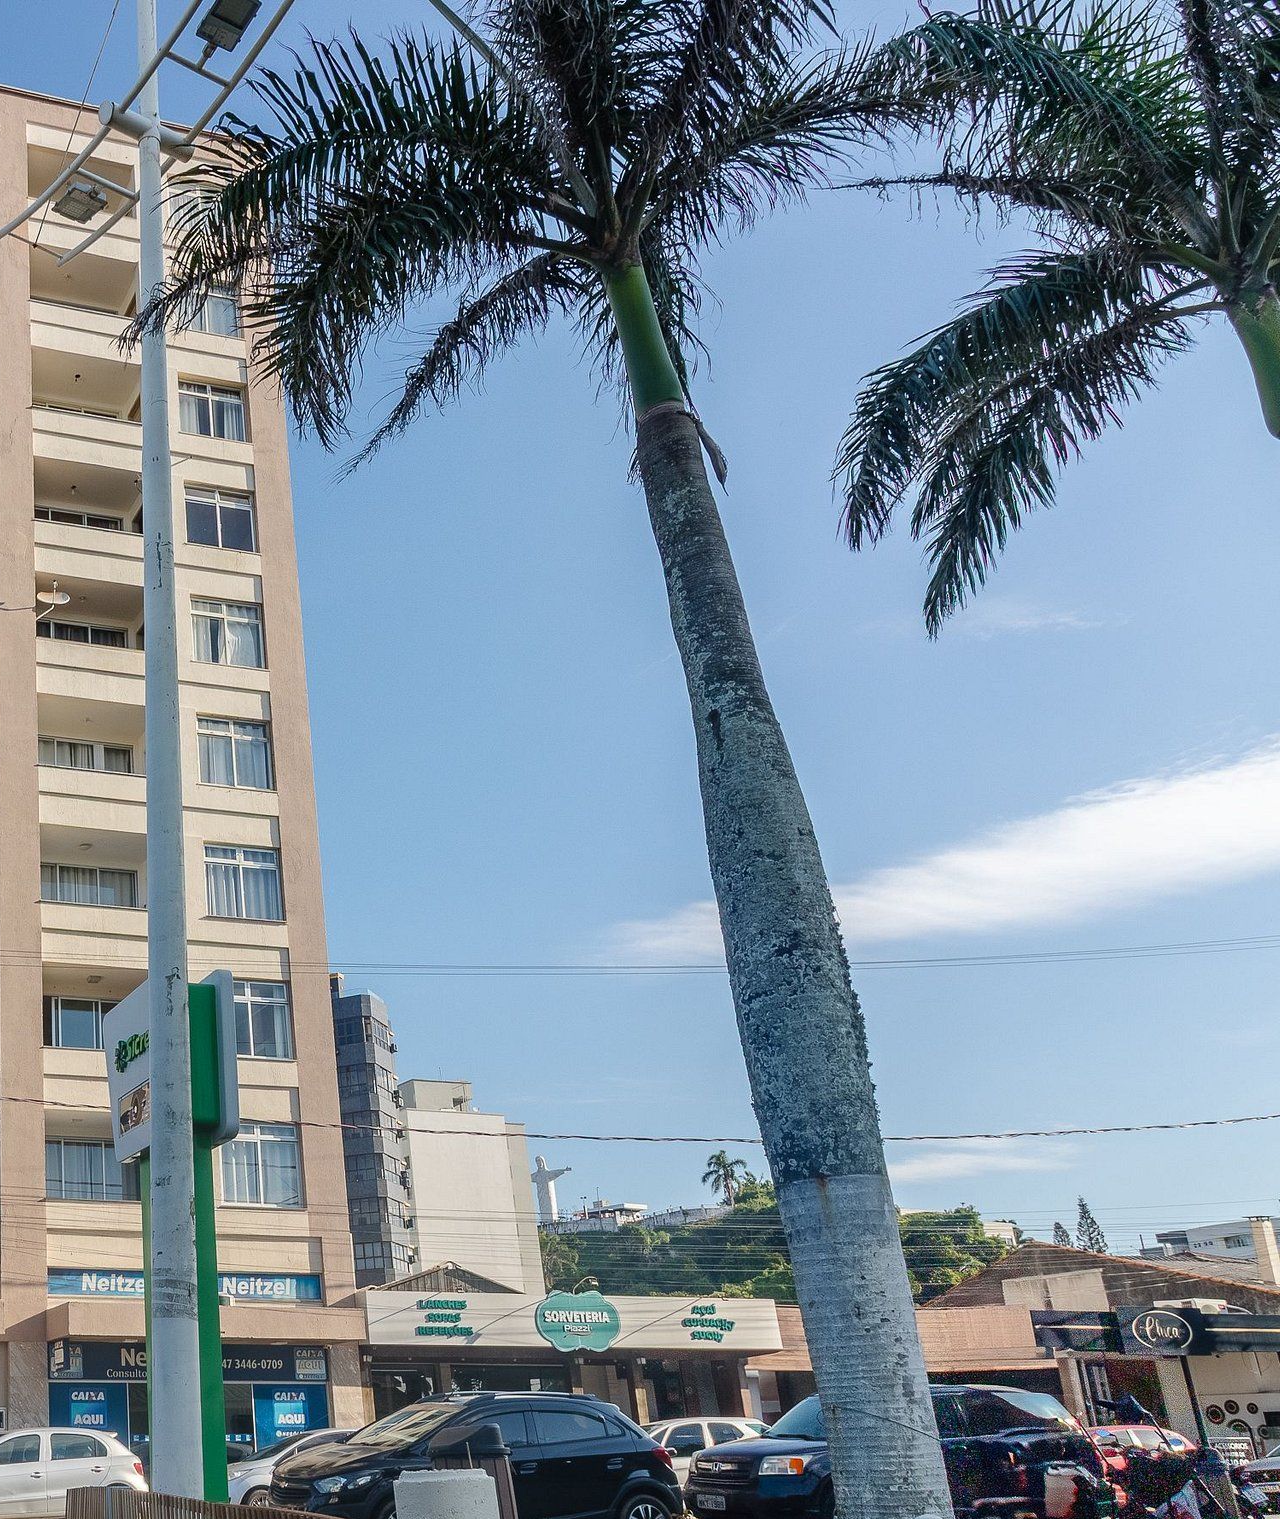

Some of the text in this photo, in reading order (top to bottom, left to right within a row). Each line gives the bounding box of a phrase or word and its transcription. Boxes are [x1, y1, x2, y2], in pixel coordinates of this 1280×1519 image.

[127, 1030, 150, 1061] Sicre
[82, 1273, 145, 1292] Neitze
[222, 1276, 291, 1296] Neitzel
[417, 1299, 467, 1310] LANCHES
[544, 1310, 610, 1324] SORVETERIA
[296, 1350, 324, 1358] CAIXA
[235, 1359, 283, 1369] 3446-0709
[298, 1361, 323, 1370] AQUI
[106, 1368, 147, 1378] Consulto
[72, 1391, 105, 1400] CAIXA
[274, 1392, 306, 1401] CAIXA
[74, 1414, 104, 1425] AQUI
[277, 1413, 306, 1425] AQUI
